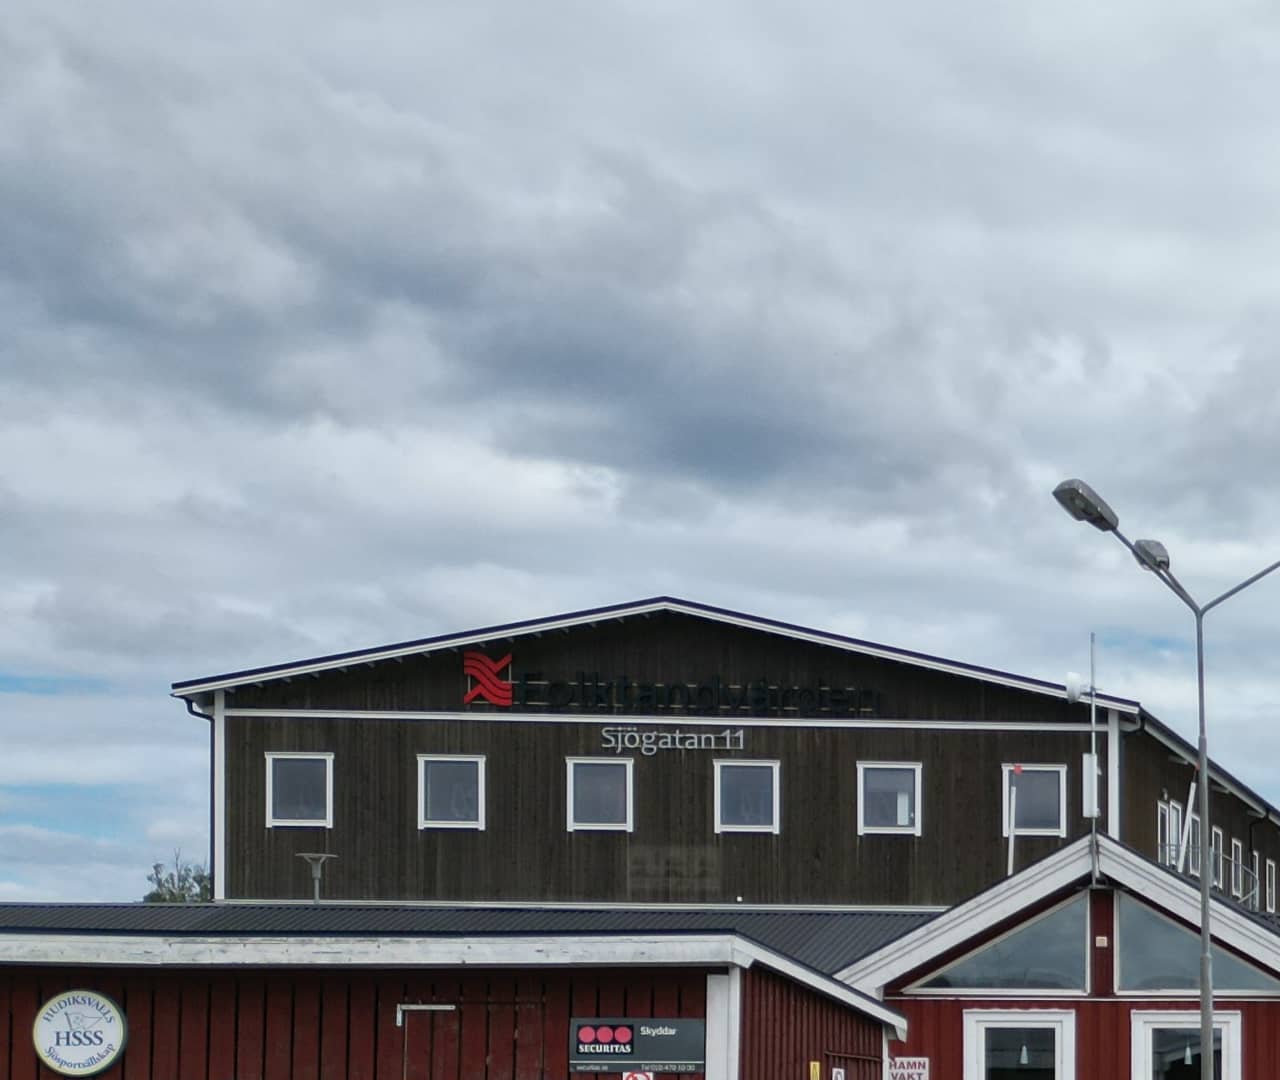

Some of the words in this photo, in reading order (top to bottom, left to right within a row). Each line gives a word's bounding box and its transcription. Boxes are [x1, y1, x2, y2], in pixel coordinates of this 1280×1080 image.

[601, 726, 715, 756] Sjögatan
[720, 729, 744, 750] 11
[42, 995, 115, 1024] HUDIKSVALLS
[640, 1026, 677, 1037] Skyddar
[55, 1030, 104, 1047] HSSS
[578, 1044, 632, 1054] SECURITAS
[888, 1060, 926, 1070] HAMN
[891, 1072, 924, 1080] VAKT
